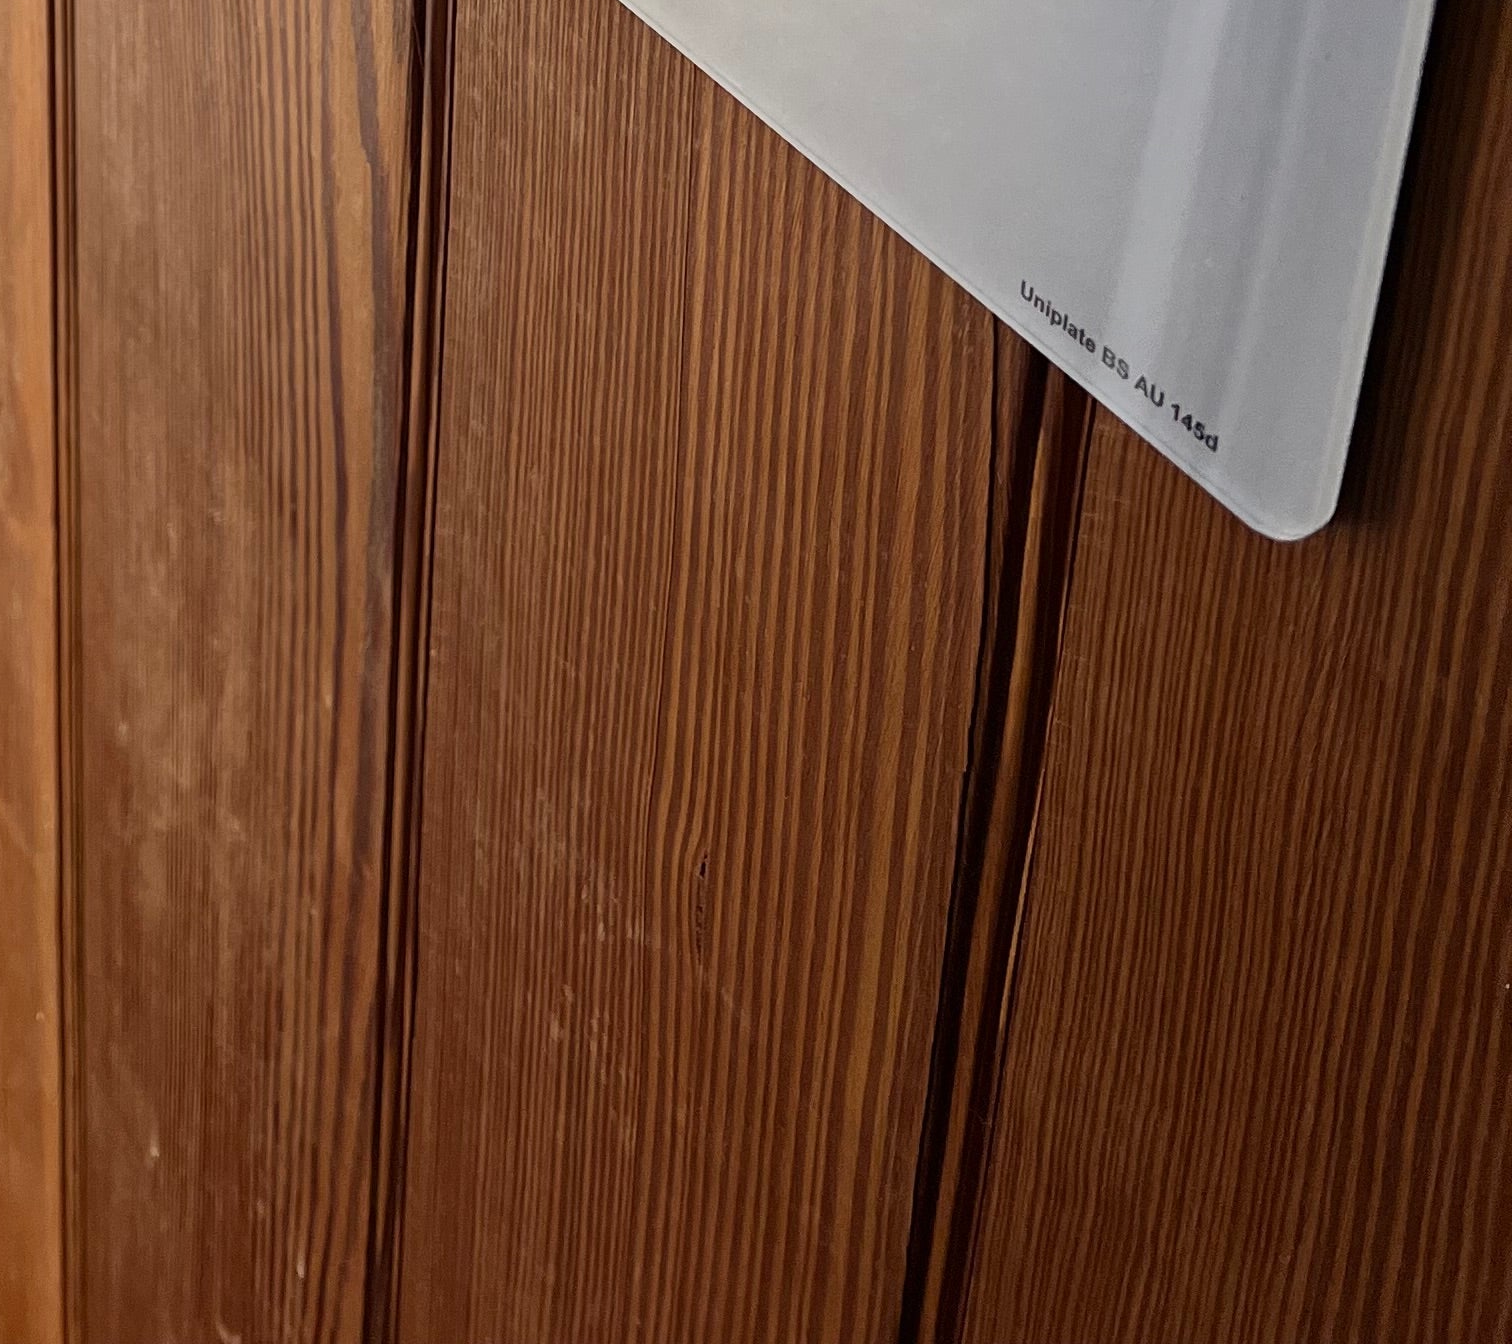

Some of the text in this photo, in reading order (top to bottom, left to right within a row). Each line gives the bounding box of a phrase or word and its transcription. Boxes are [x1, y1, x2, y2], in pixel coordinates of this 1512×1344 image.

[1020, 279, 1219, 453] Uniplate BS AU 145d
